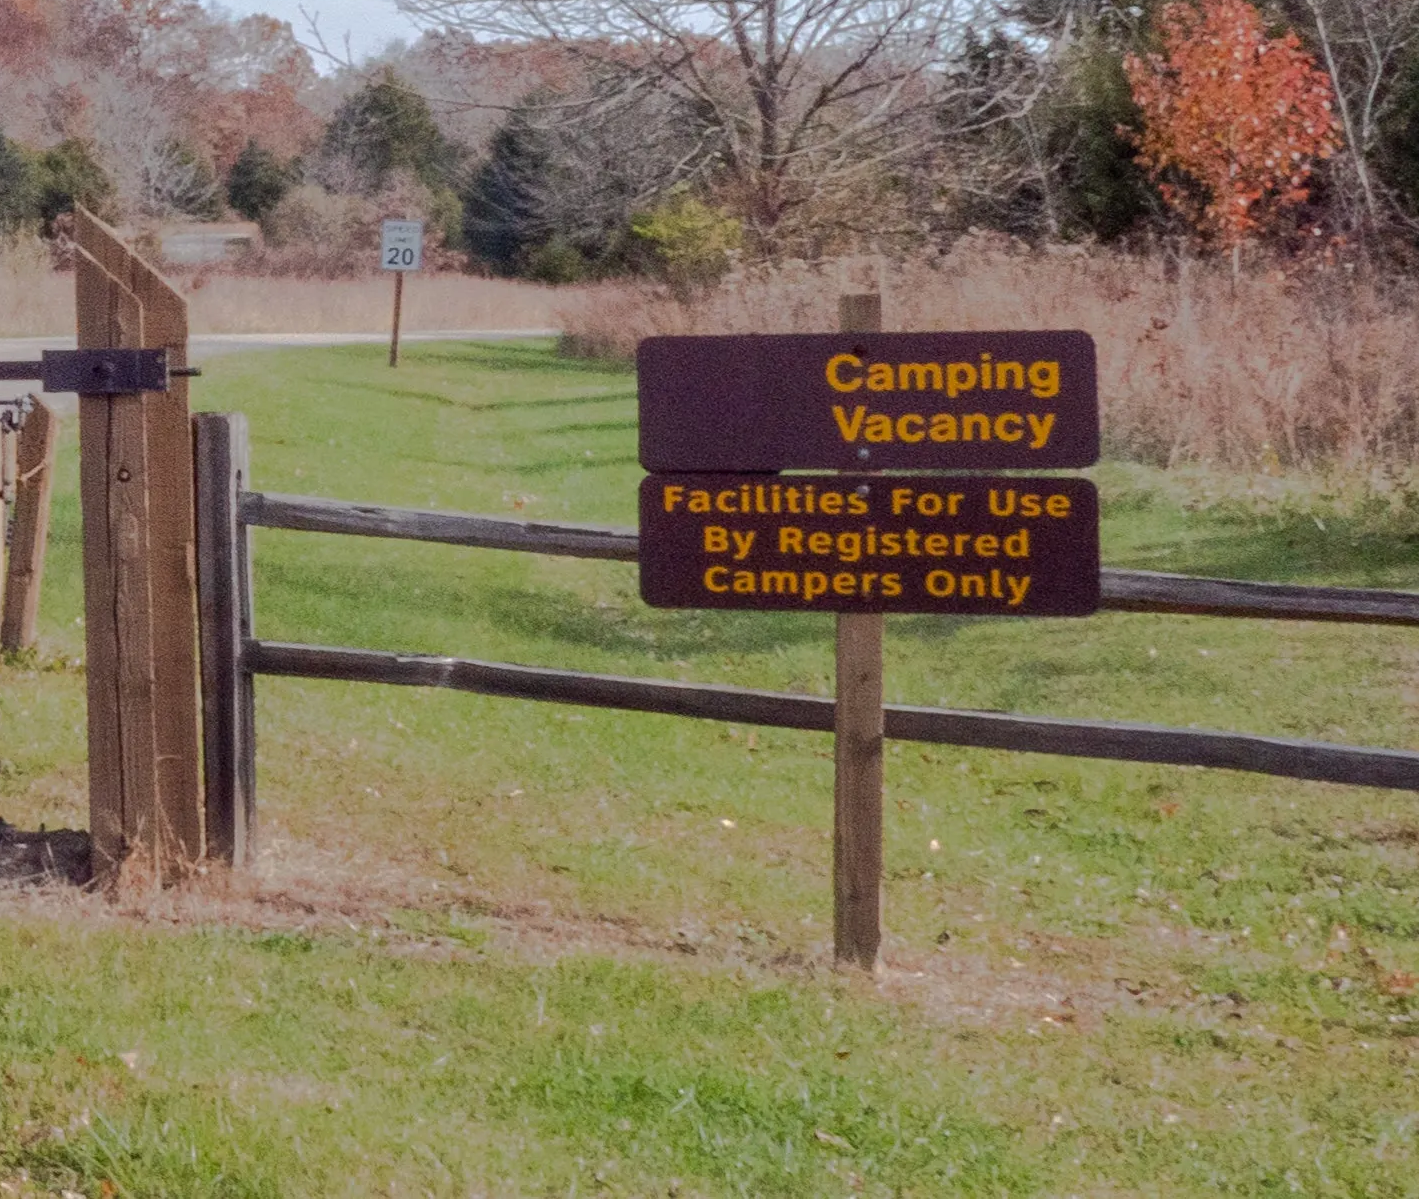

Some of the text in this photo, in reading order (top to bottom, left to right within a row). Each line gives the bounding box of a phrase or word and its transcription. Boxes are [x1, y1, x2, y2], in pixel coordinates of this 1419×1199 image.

[387, 247, 414, 266] 20
[826, 353, 1061, 397] Camping
[832, 405, 1055, 449] Vacancy
[664, 484, 1071, 518] Facilities For Use
[704, 526, 1029, 562] By Registered
[704, 566, 1030, 605] Campers Only
